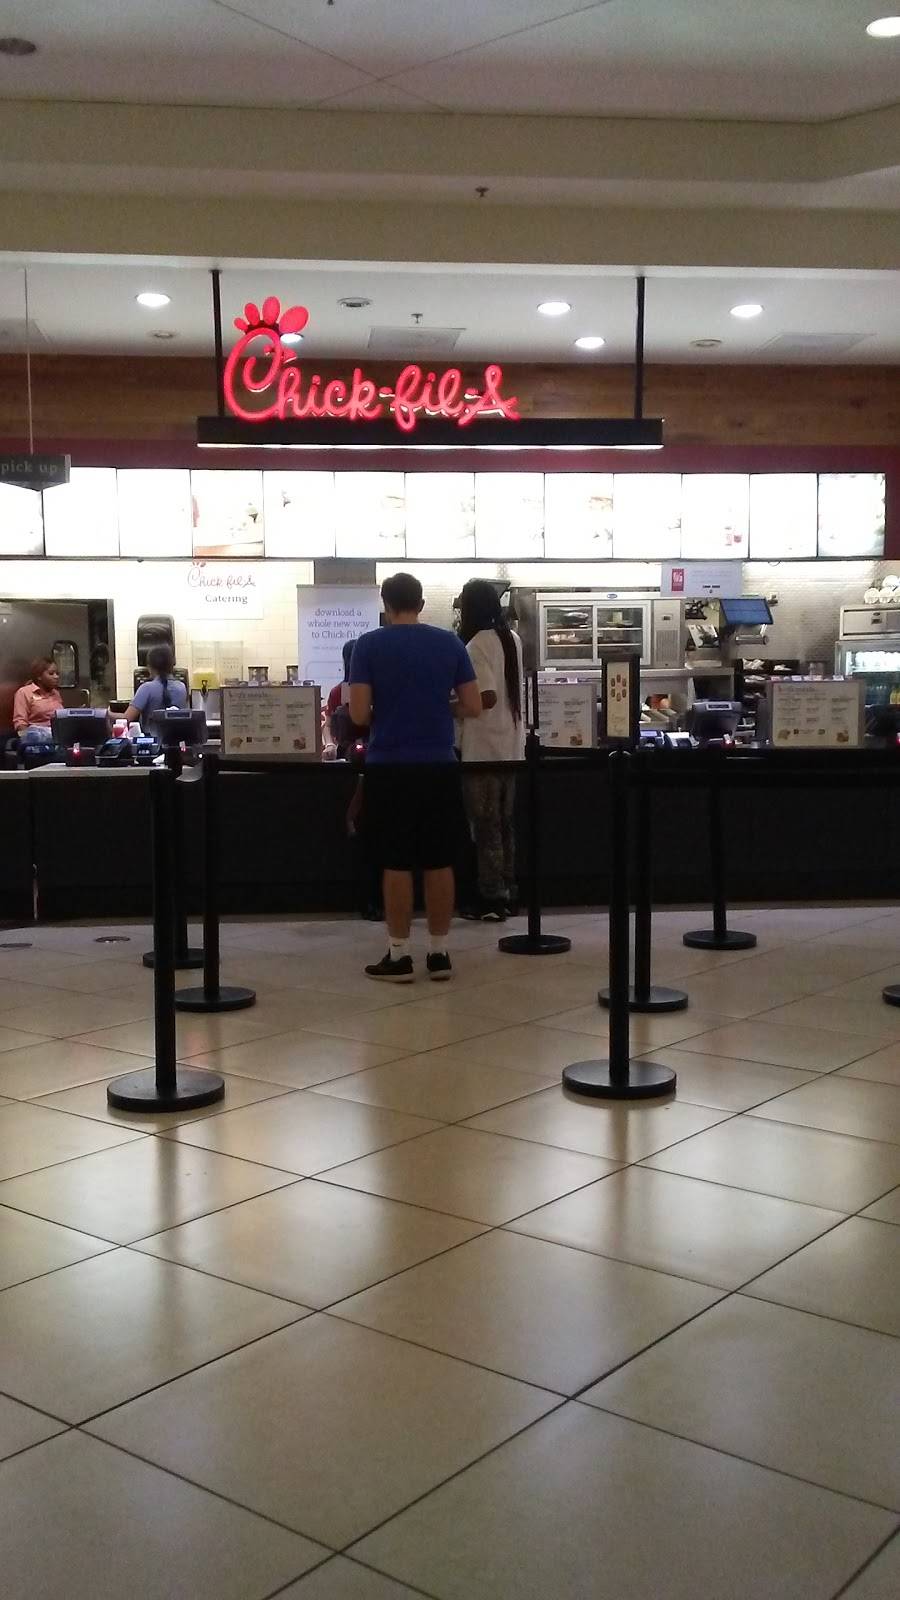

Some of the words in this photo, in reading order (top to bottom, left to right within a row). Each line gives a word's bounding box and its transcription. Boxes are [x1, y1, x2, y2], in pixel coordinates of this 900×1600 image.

[223, 297, 520, 431] Chick-fil-A
[1, 459, 33, 475] pick
[39, 463, 58, 476] up
[205, 595, 248, 605] Catering
[314, 608, 355, 617] download
[307, 619, 332, 628] whole
[333, 620, 350, 628] new
[352, 620, 371, 629] way
[311, 631, 320, 639] to
